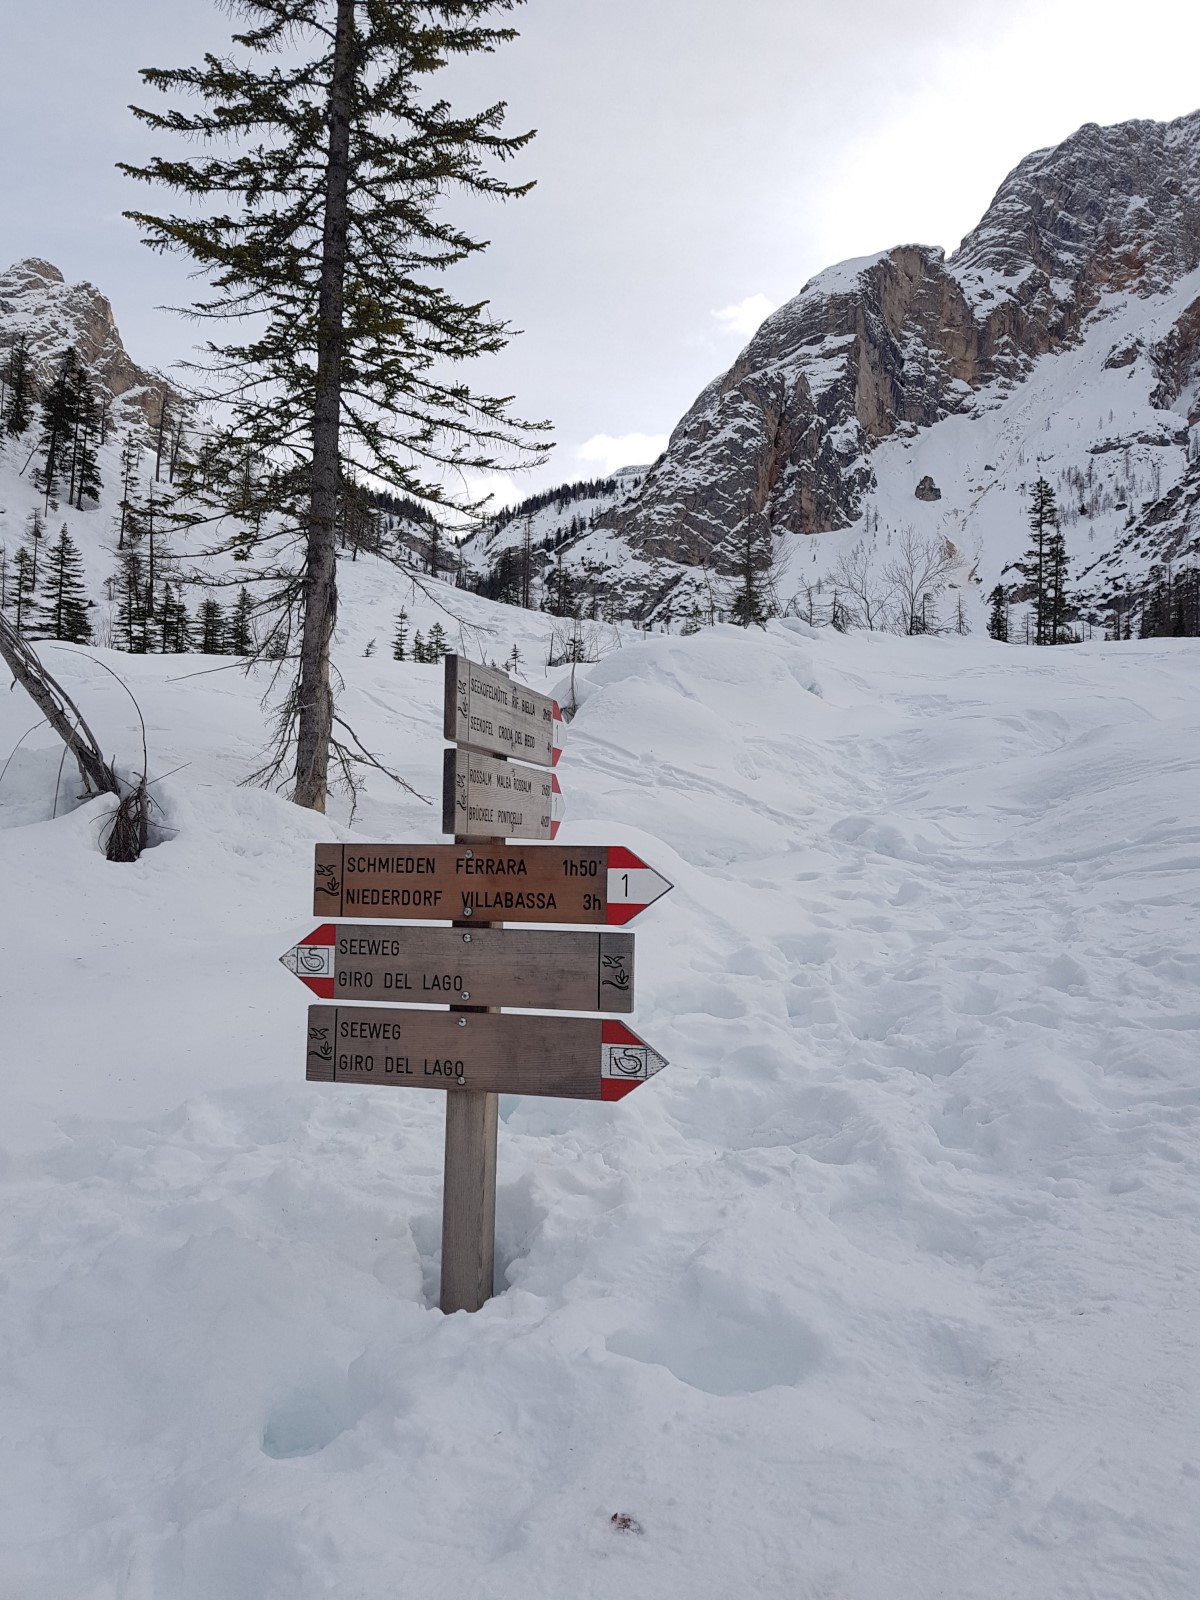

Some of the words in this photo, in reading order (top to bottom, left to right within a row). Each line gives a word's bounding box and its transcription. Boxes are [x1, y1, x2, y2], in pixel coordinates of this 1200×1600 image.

[522, 700, 535, 716] BIELLA
[470, 716, 493, 736] SEEKOFEL
[498, 726, 513, 741] CRODA
[514, 731, 522, 745] DEL
[469, 768, 492, 786] ROSSALM
[497, 774, 511, 789] MALGA
[513, 778, 532, 793] ROSSALM
[468, 805, 493, 823] BRÜCKELE
[497, 810, 522, 825] PONTICELLO
[347, 857, 435, 874] SCHMIEDEN
[455, 858, 528, 875] FERRARA
[562, 860, 602, 877] 1h50'
[621, 874, 629, 897] 1
[345, 889, 442, 907] NIEDERDORF
[461, 892, 557, 910] VILLABASSA
[583, 894, 601, 911] 3h
[339, 939, 400, 956] SEEWEG
[338, 972, 373, 989] GIRO
[384, 973, 412, 990] DEL
[423, 974, 463, 991] LAGO
[340, 1022, 401, 1040] SEEWEG
[339, 1054, 374, 1072] GIRO
[384, 1056, 413, 1074] DEL
[423, 1058, 464, 1077] LAGO
